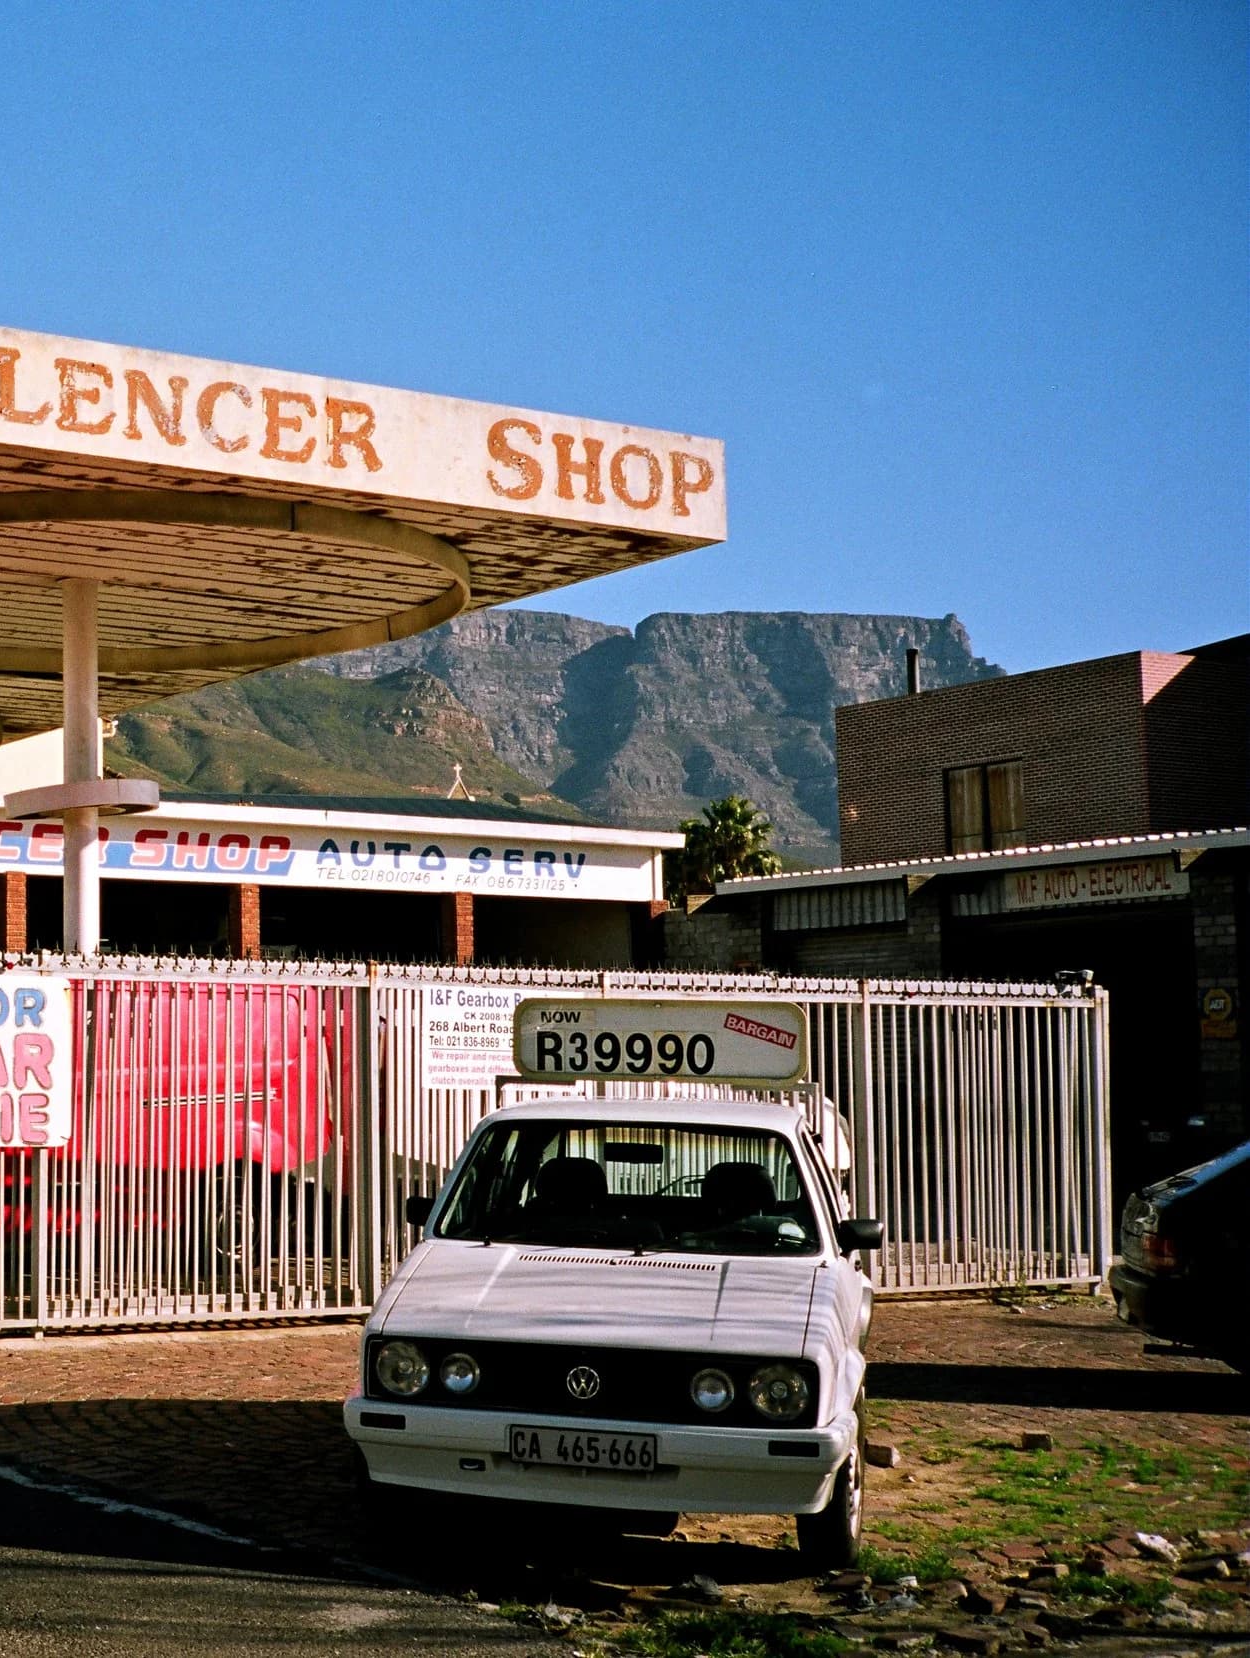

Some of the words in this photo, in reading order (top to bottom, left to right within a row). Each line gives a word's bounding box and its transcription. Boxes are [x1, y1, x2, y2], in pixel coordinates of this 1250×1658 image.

[486, 417, 715, 518] SHOP
[129, 828, 291, 872] SHOP
[316, 838, 447, 872] AUTO
[468, 846, 586, 879] SERV
[1044, 868, 1079, 901] AUTO
[1089, 862, 1172, 898] ELECTRICAL
[457, 990, 510, 1009] Gearbox
[429, 1021, 449, 1032] 268
[452, 1021, 486, 1034] Albert
[540, 1010, 582, 1024] NOW
[725, 1014, 796, 1049] BARGAIN
[446, 1036, 461, 1047] 021
[472, 1052, 487, 1061] and
[536, 1030, 716, 1076] R39990
[428, 1064, 469, 1074] gearboxes
[471, 1065, 486, 1073] and
[513, 1430, 542, 1460] CA
